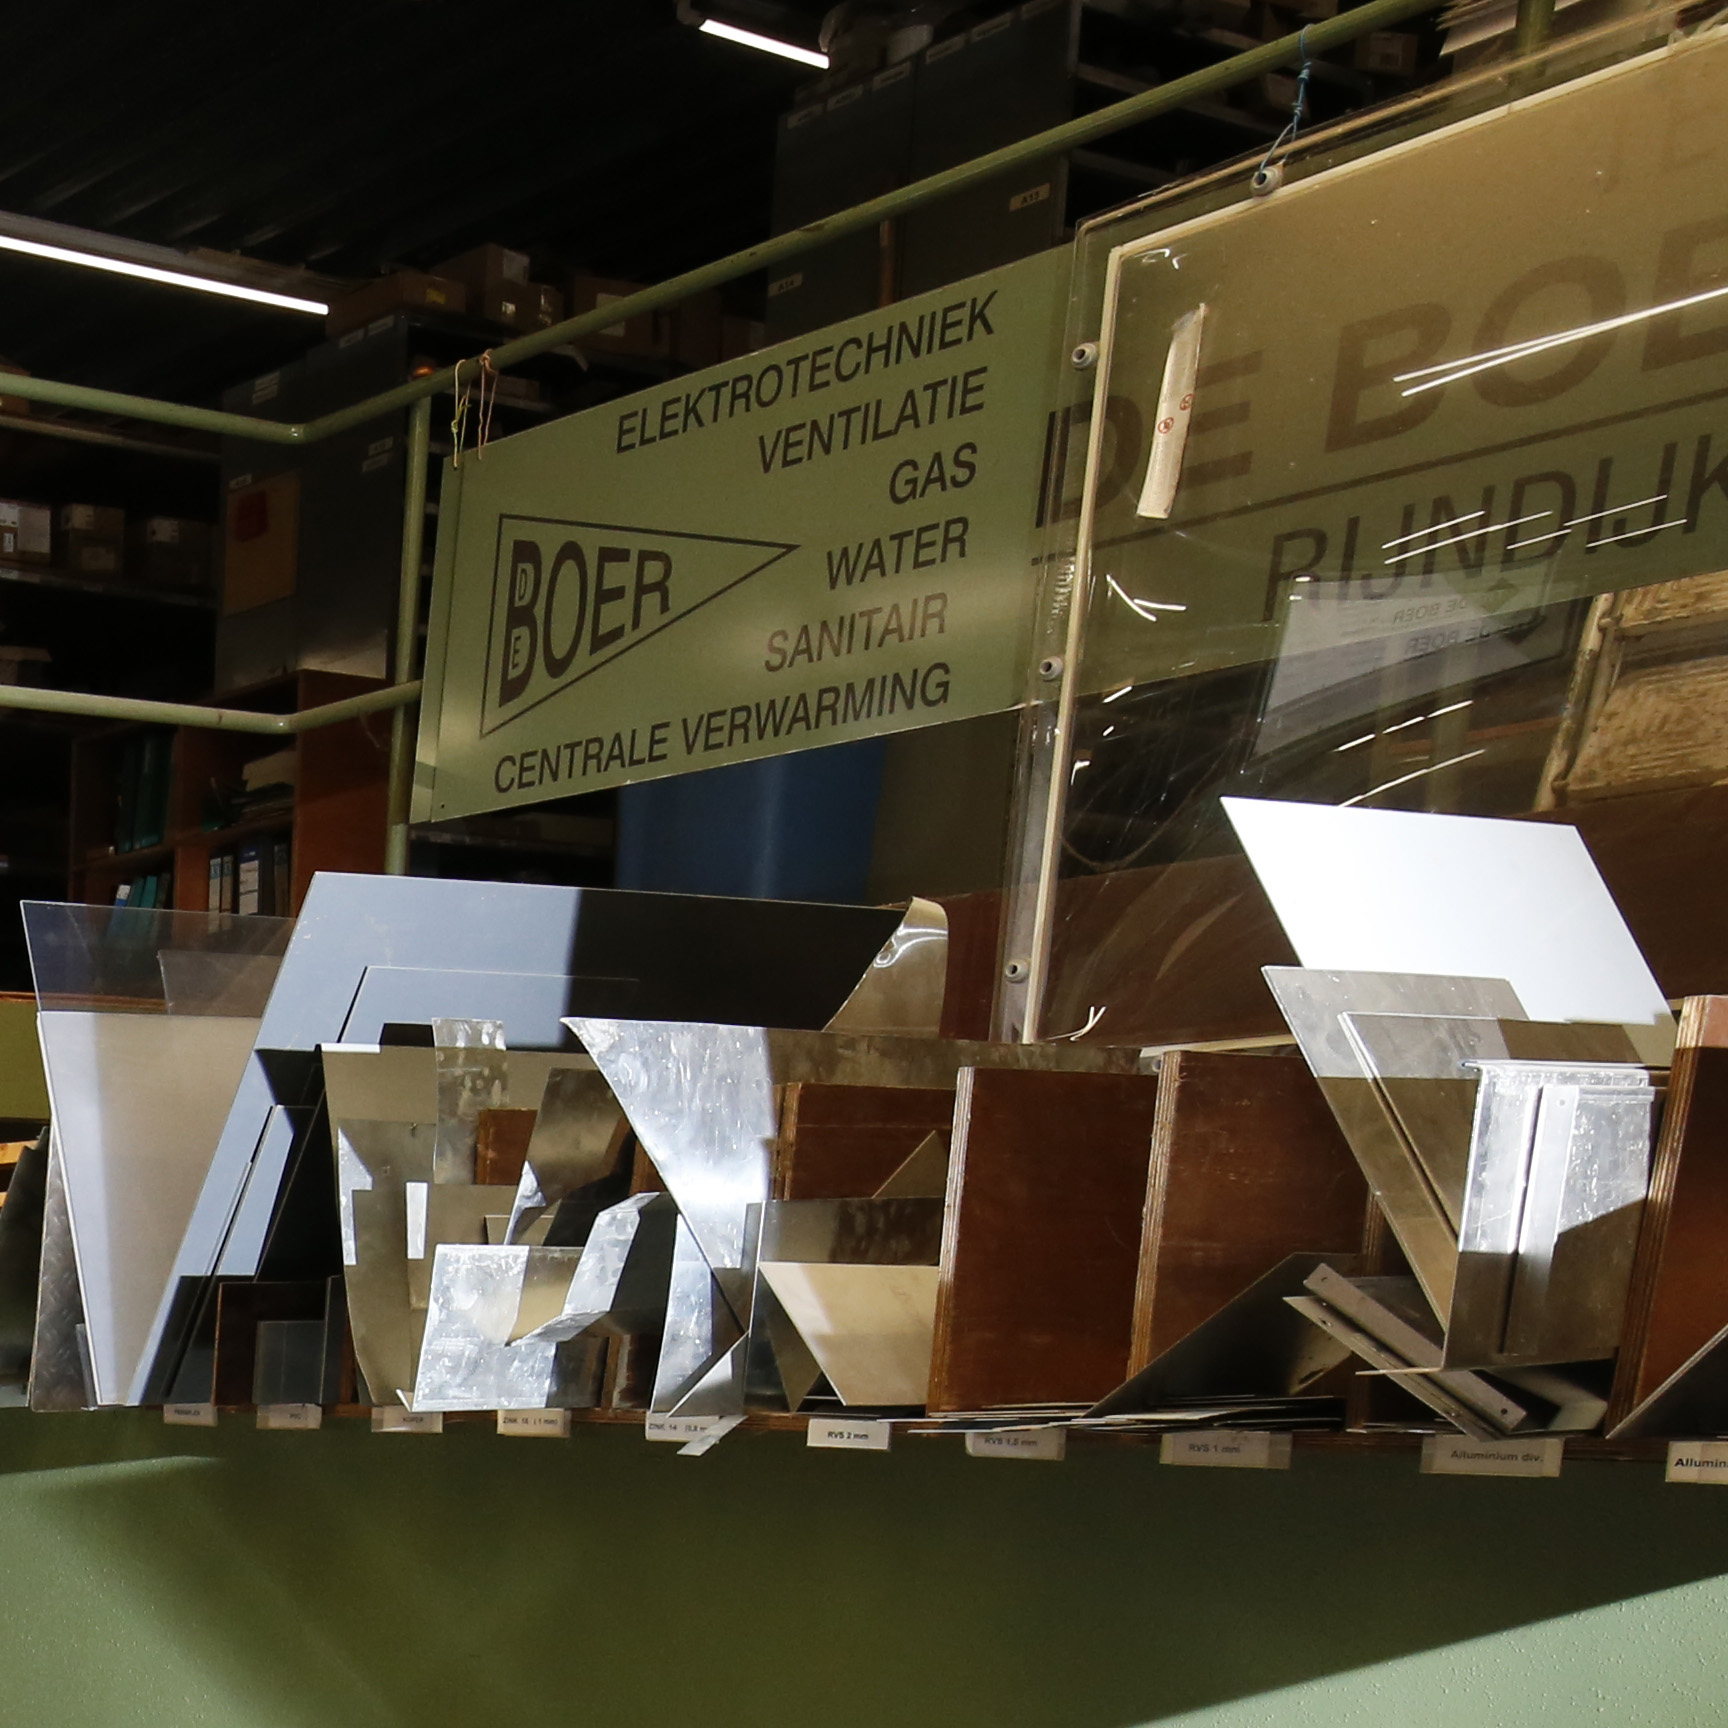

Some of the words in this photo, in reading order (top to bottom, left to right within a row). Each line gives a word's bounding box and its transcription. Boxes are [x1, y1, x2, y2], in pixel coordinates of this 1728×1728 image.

[615, 289, 999, 455] ELEKTROTECHNIEK
[757, 366, 989, 475] VENTILATIE
[1034, 349, 1264, 531] DE
[888, 441, 978, 505] GAS
[825, 516, 970, 592] WATER
[1261, 433, 1728, 623] RIJNDIJK
[497, 538, 674, 708] BOER
[763, 592, 949, 673] SANITAIR
[494, 721, 671, 794] CENTRALE
[681, 662, 952, 756] VERWARMING
[827, 1431, 845, 1440] RVS
[846, 1431, 853, 1440] 2
[1188, 1443, 1210, 1453] RVS
[1220, 1445, 1240, 1454] mm
[1450, 1449, 1519, 1462] Alluminium
[1521, 1452, 1544, 1463] div.
[1673, 1457, 1728, 1468] Allumin
